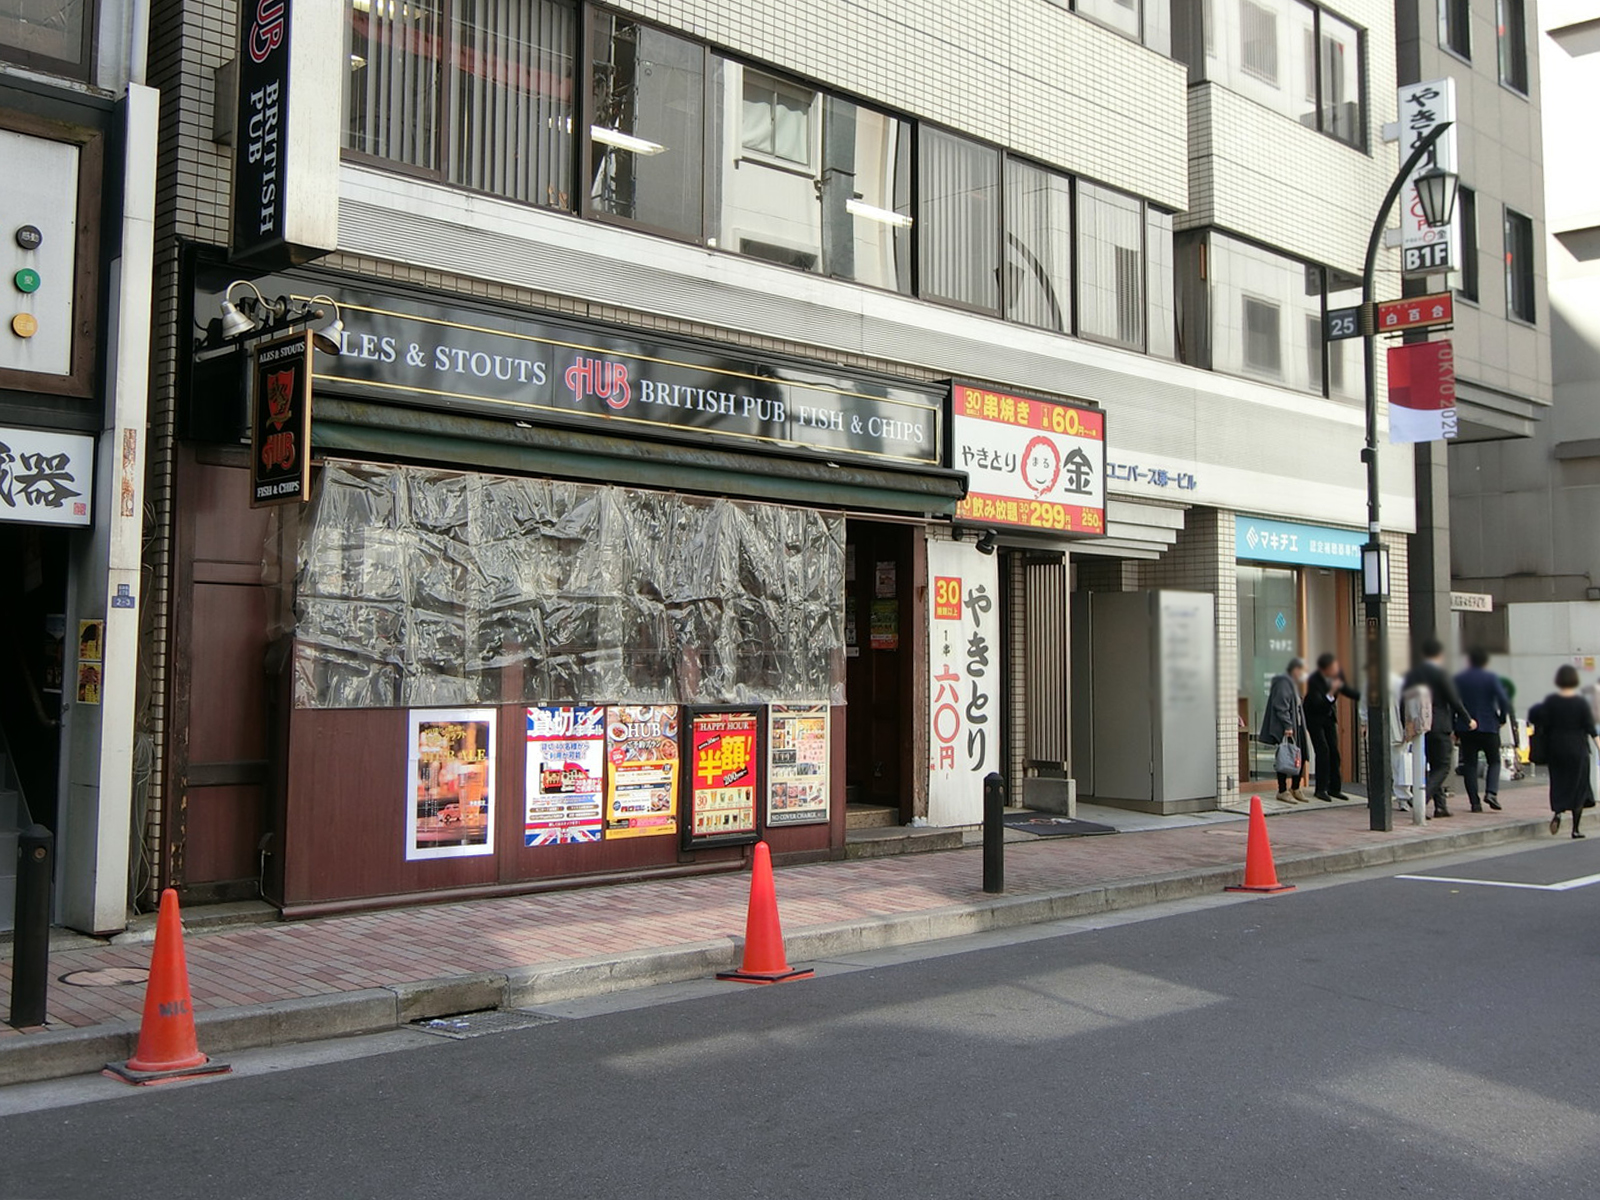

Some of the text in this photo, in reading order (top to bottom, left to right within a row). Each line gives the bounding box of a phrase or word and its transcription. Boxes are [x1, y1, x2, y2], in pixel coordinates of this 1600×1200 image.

[250, 0, 284, 63] UB
[249, 87, 264, 164] PUB
[260, 79, 280, 235] BRITISH
[1406, 243, 1447, 270] B1F
[1331, 317, 1354, 336] 25
[259, 341, 305, 363] ALES & STOUTS
[339, 331, 546, 386] LES & STOUTS
[565, 357, 631, 409] HUB
[1437, 341, 1458, 439] TOKYO 2020
[640, 379, 785, 422] BRITISH PUB
[965, 390, 981, 410] 30
[984, 394, 1030, 425] 串焼き
[799, 406, 923, 443] FISH & CHIPS
[262, 432, 295, 473] HUB
[962, 445, 1016, 473] やきとり
[1032, 457, 1050, 469] まる
[1063, 447, 1093, 495] 金
[257, 486, 273, 497] FISH
[279, 481, 300, 494] CHIPS
[972, 497, 1018, 521] 飲み放題
[1261, 532, 1298, 552] マキチエ
[937, 580, 959, 604] 30
[963, 584, 992, 772] やきとり
[627, 722, 661, 738] HUB
[700, 721, 749, 731] HAPPY HOUR
